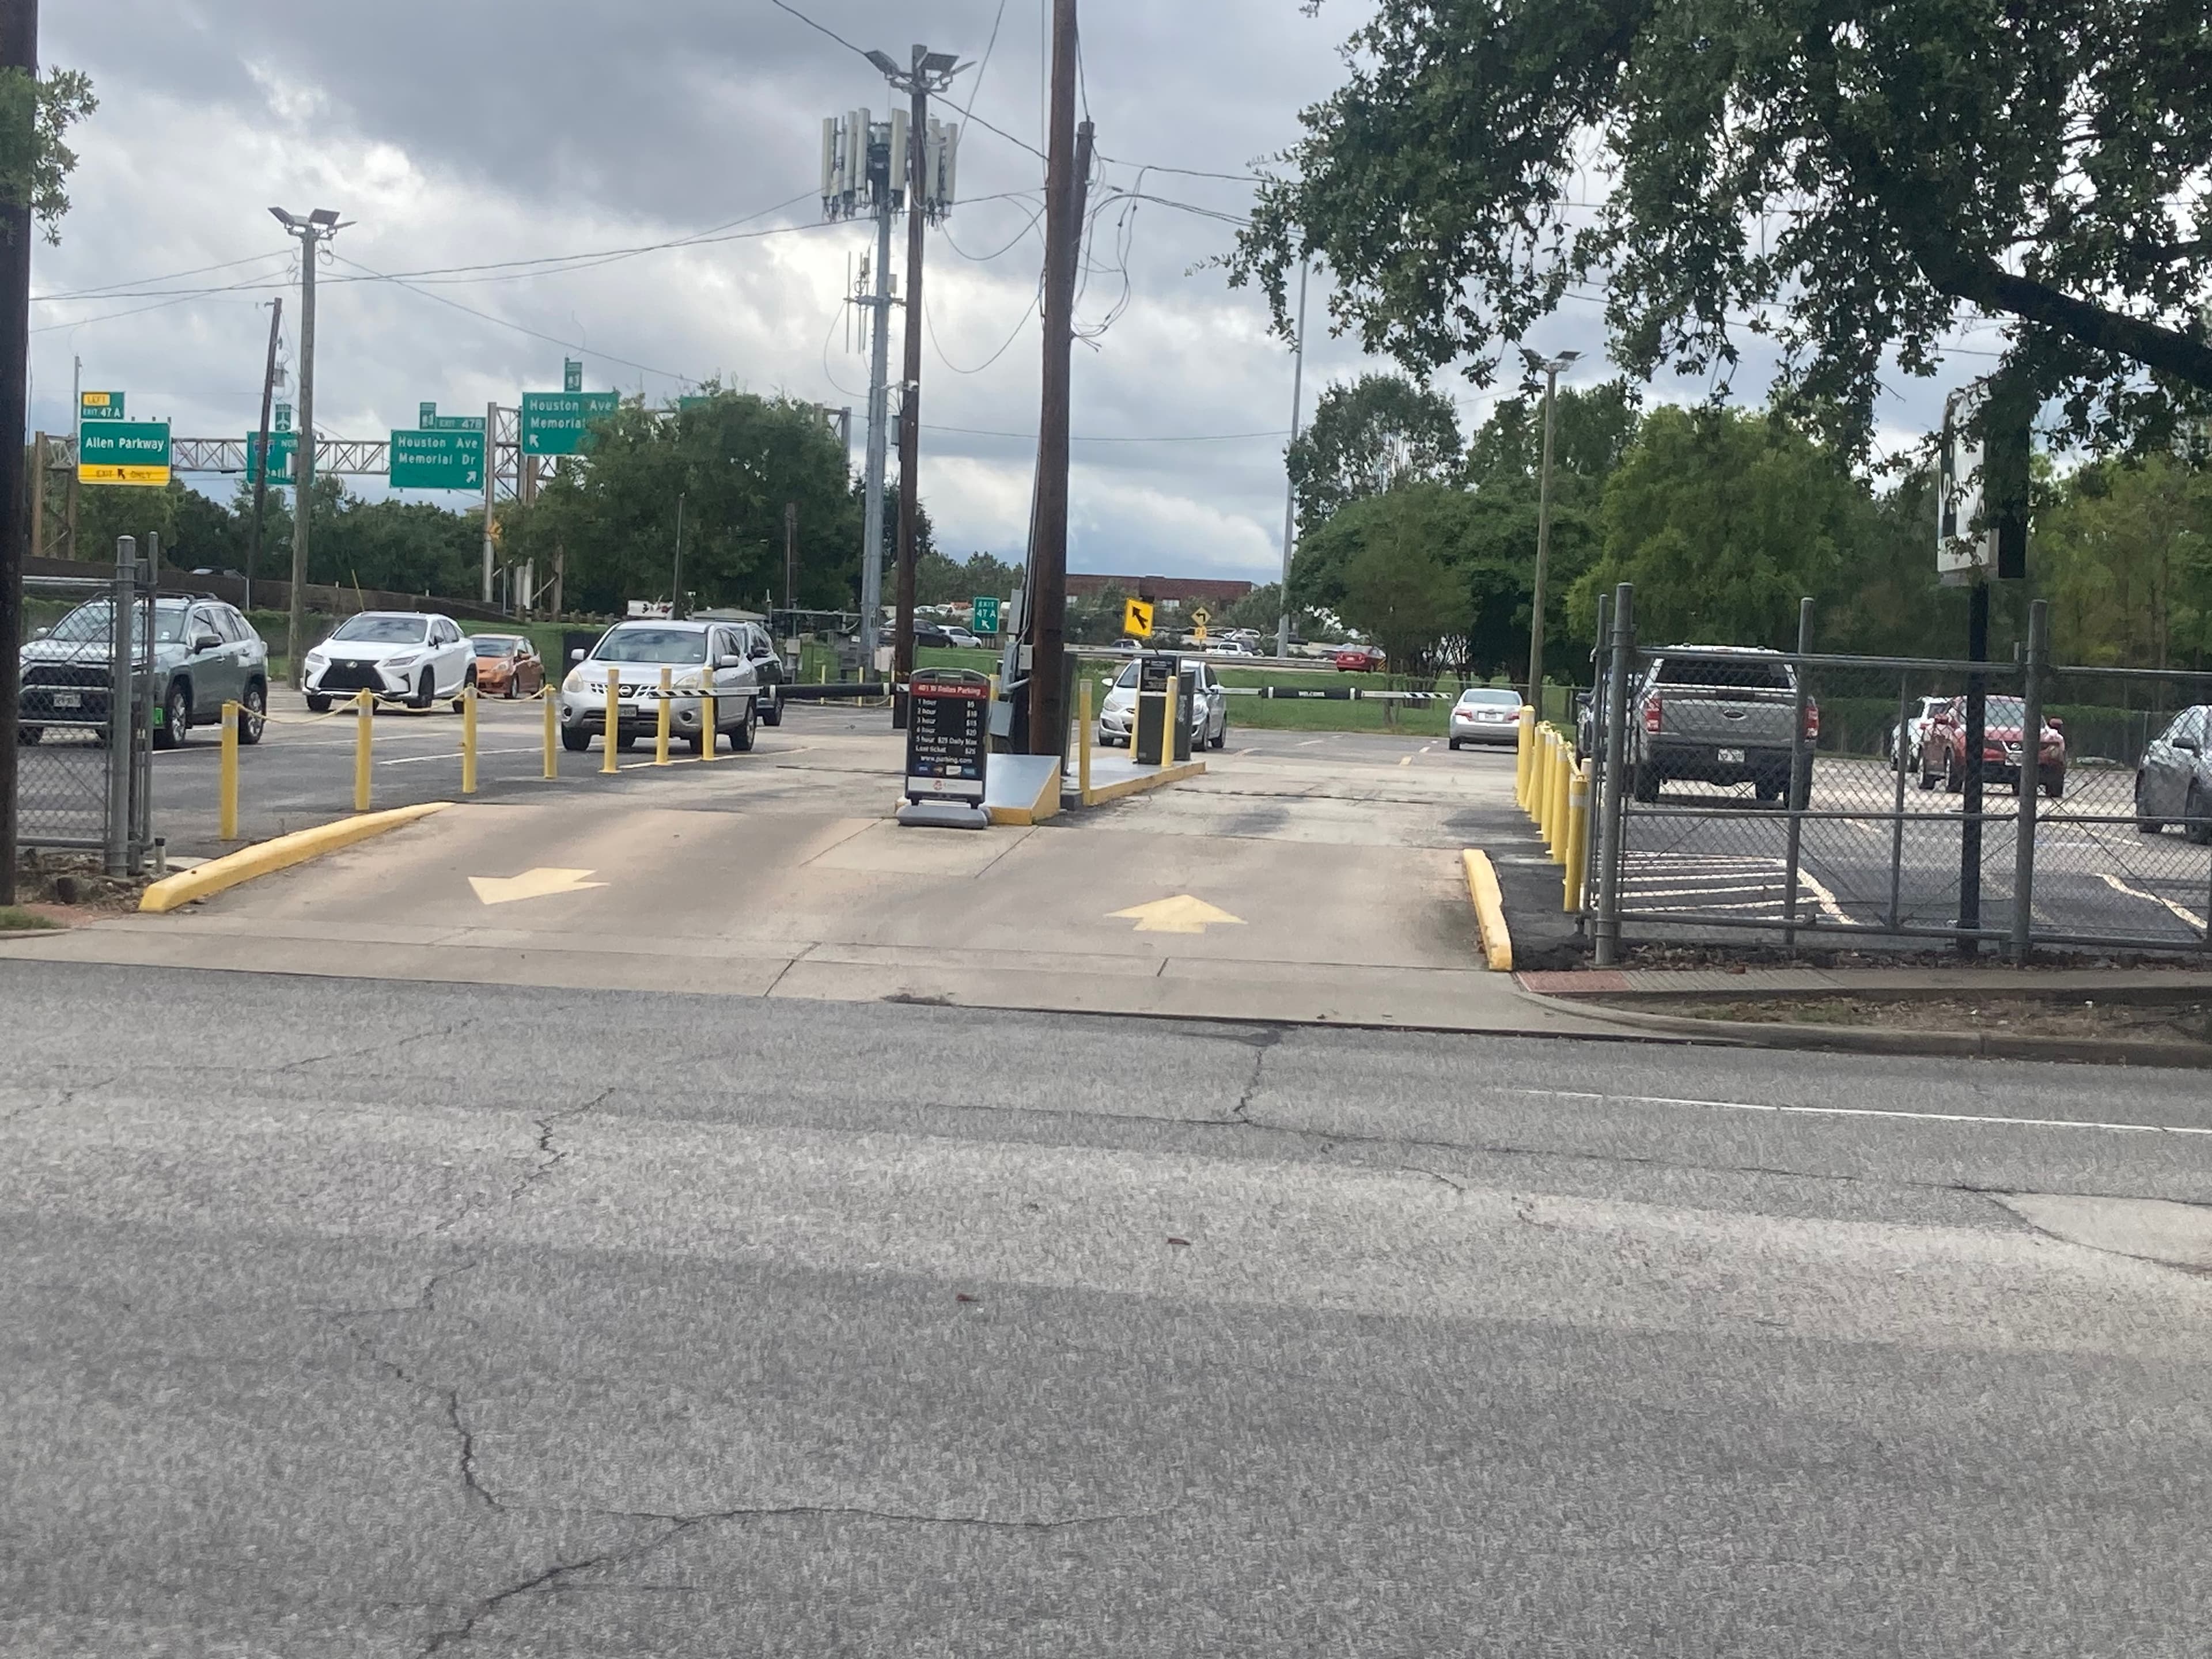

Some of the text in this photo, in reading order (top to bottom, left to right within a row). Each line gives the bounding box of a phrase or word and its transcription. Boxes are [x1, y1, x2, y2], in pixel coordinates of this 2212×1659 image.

[529, 400, 612, 411] Houston Ave
[439, 419, 482, 429] EXIT 47B
[531, 417, 586, 429] Memorial
[85, 437, 165, 452] Allen Parkway
[398, 436, 478, 448] Houston Ave
[399, 453, 476, 465] Memorial Dr
[130, 471, 151, 479] ONLY
[957, 687, 981, 696] Parking
[949, 737, 964, 745] Daily
[921, 756, 973, 764] www.parking.com
